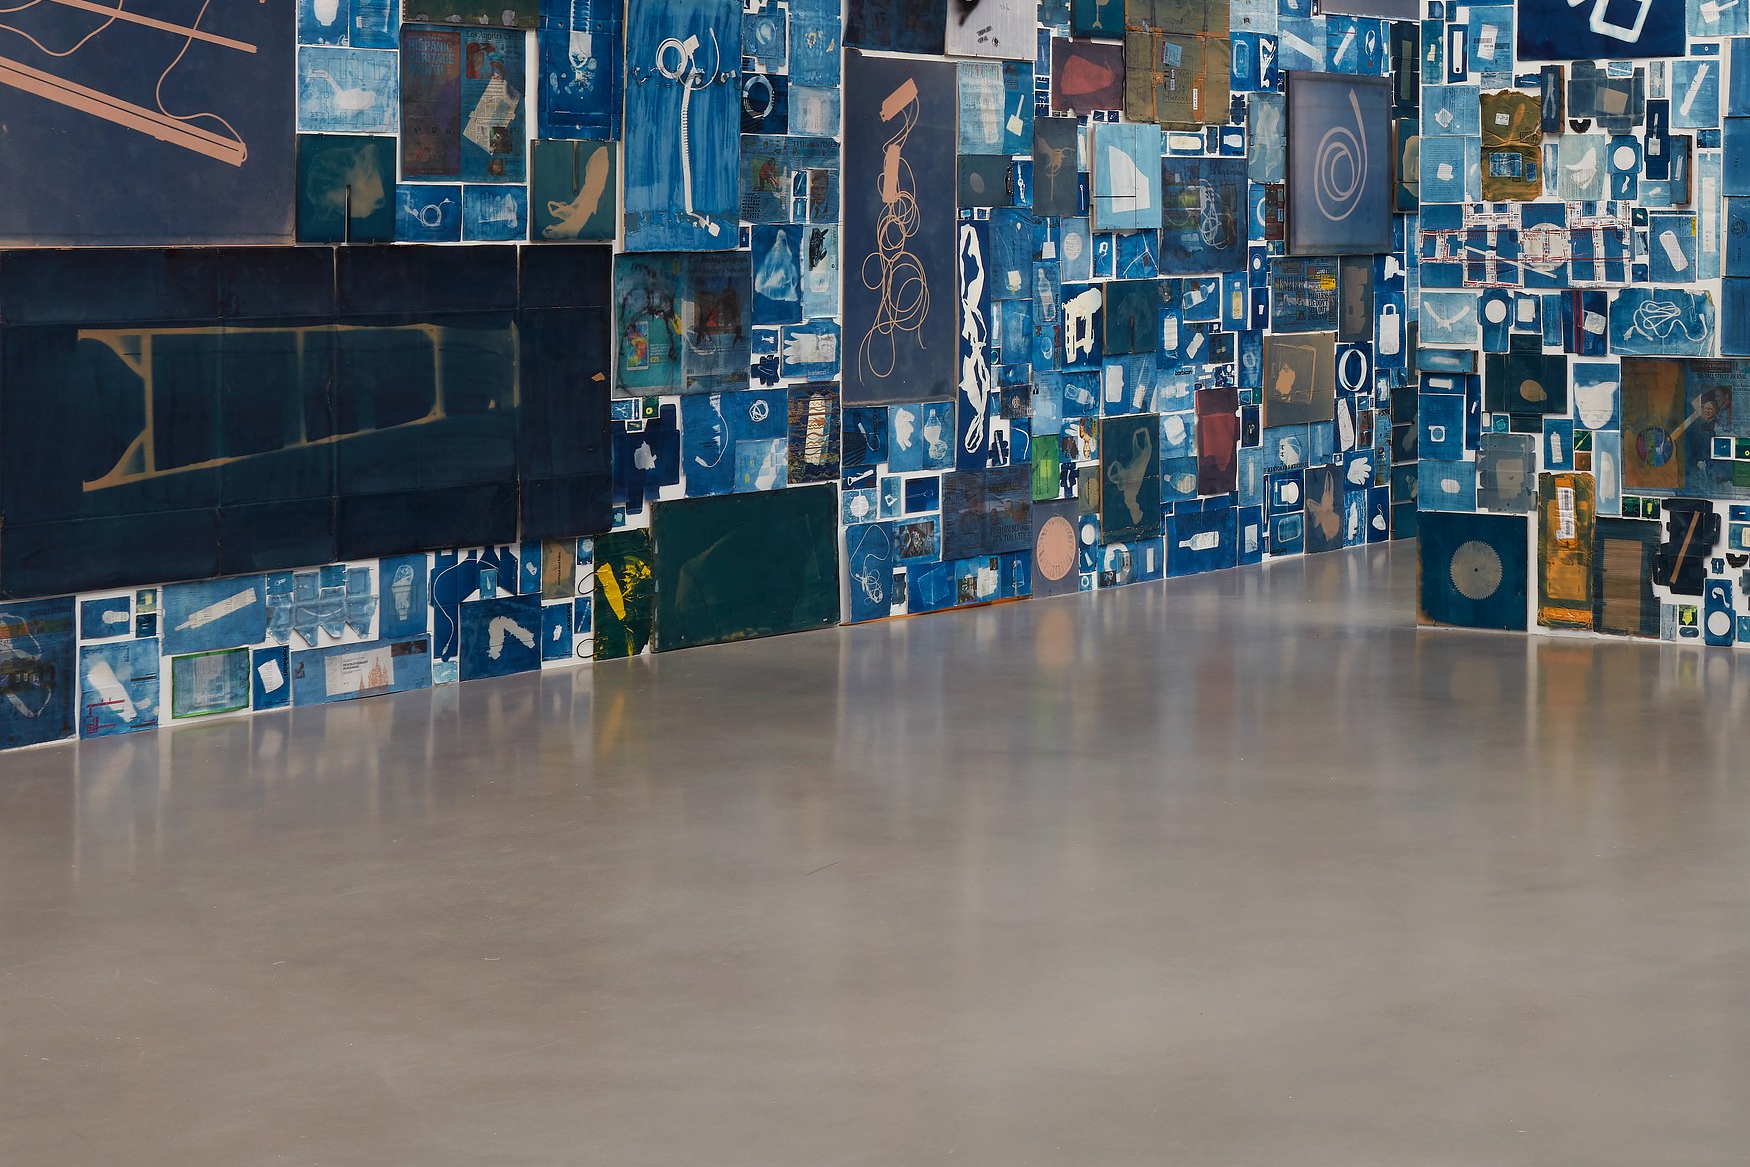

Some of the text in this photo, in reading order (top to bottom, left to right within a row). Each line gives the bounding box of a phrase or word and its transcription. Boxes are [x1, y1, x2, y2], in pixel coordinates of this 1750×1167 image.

[479, 31, 503, 40] Angeles
[407, 35, 453, 52] HISPANIC
[407, 50, 454, 65] HERITAGE
